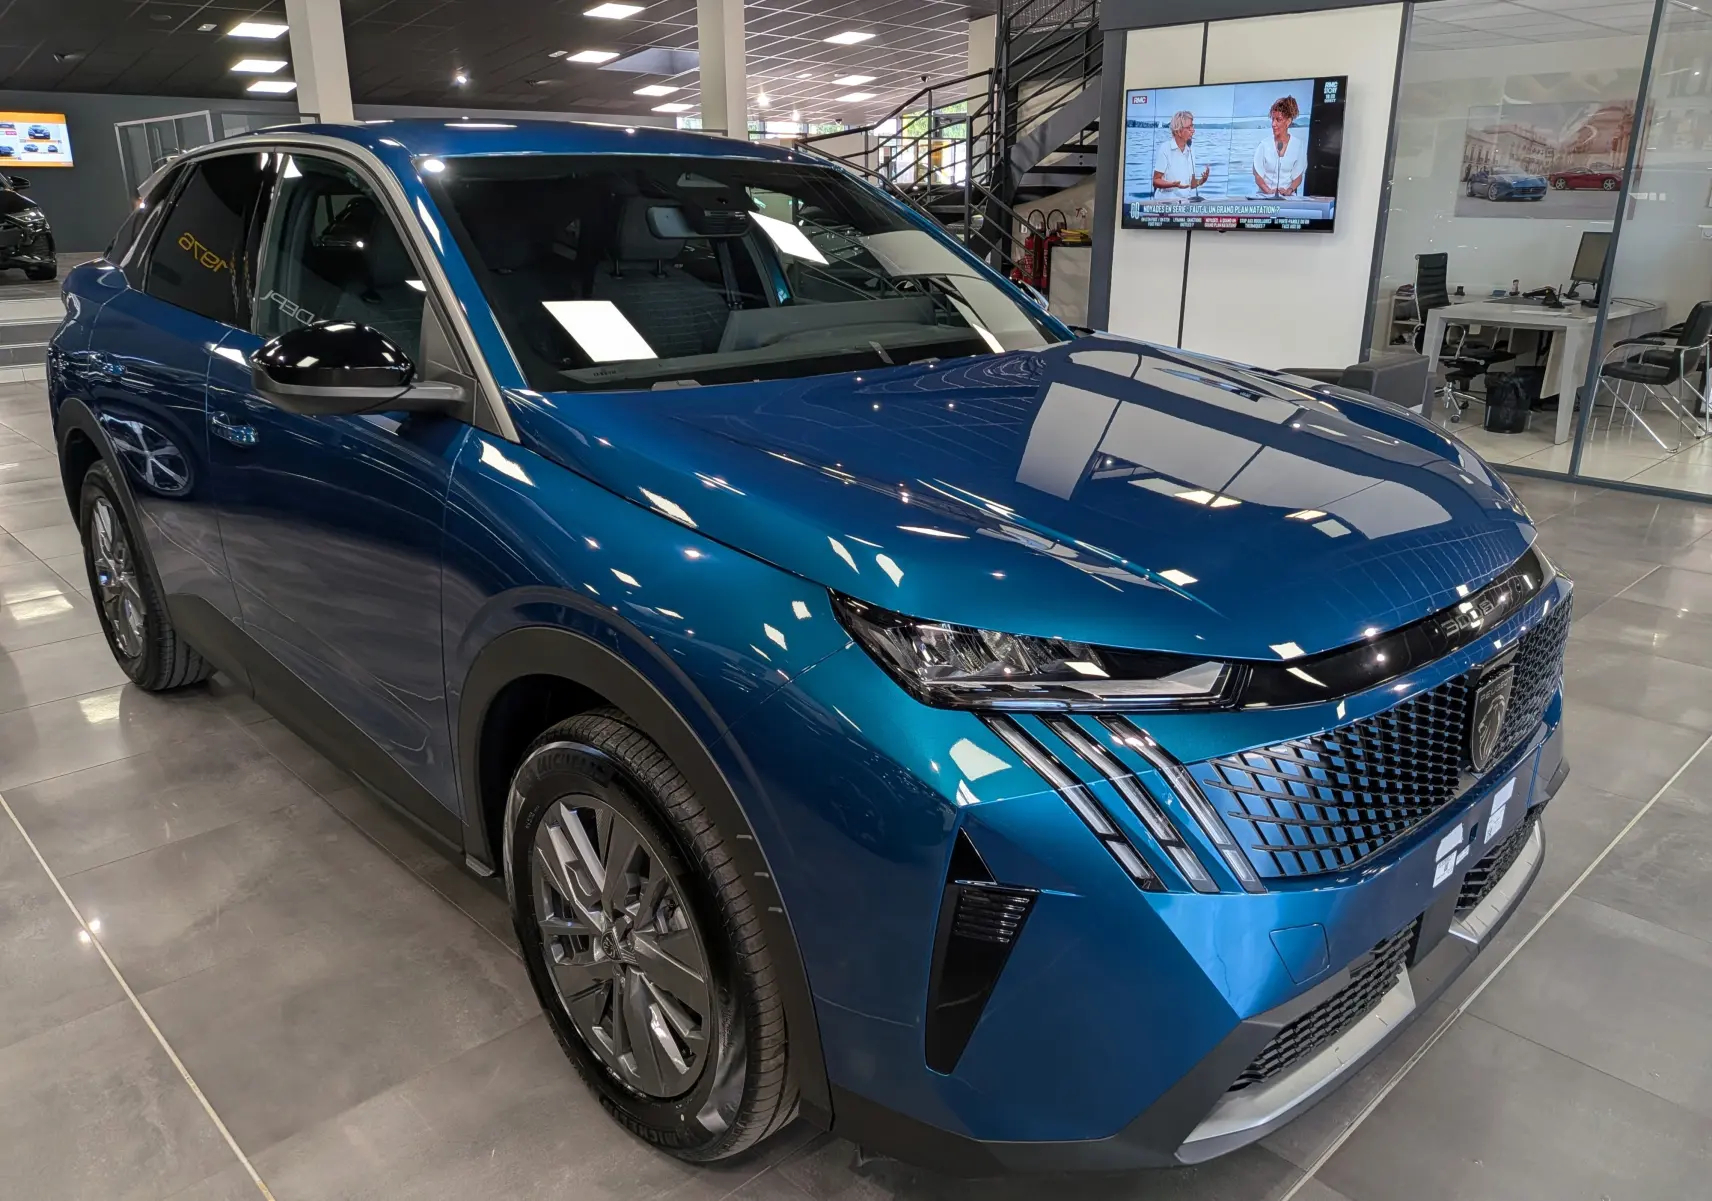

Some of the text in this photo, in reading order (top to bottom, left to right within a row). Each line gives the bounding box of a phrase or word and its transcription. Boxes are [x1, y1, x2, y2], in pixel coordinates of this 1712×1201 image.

[1133, 96, 1147, 104] RMC
[1143, 205, 1165, 213] NOYADES
[1209, 205, 1216, 214] UN
[1216, 205, 1234, 214] GRAND
[1235, 205, 1249, 214] PLAN
[1249, 205, 1275, 214] NATATION
[1441, 599, 1495, 637] 3008
[1479, 676, 1512, 703] PEUGEOT
